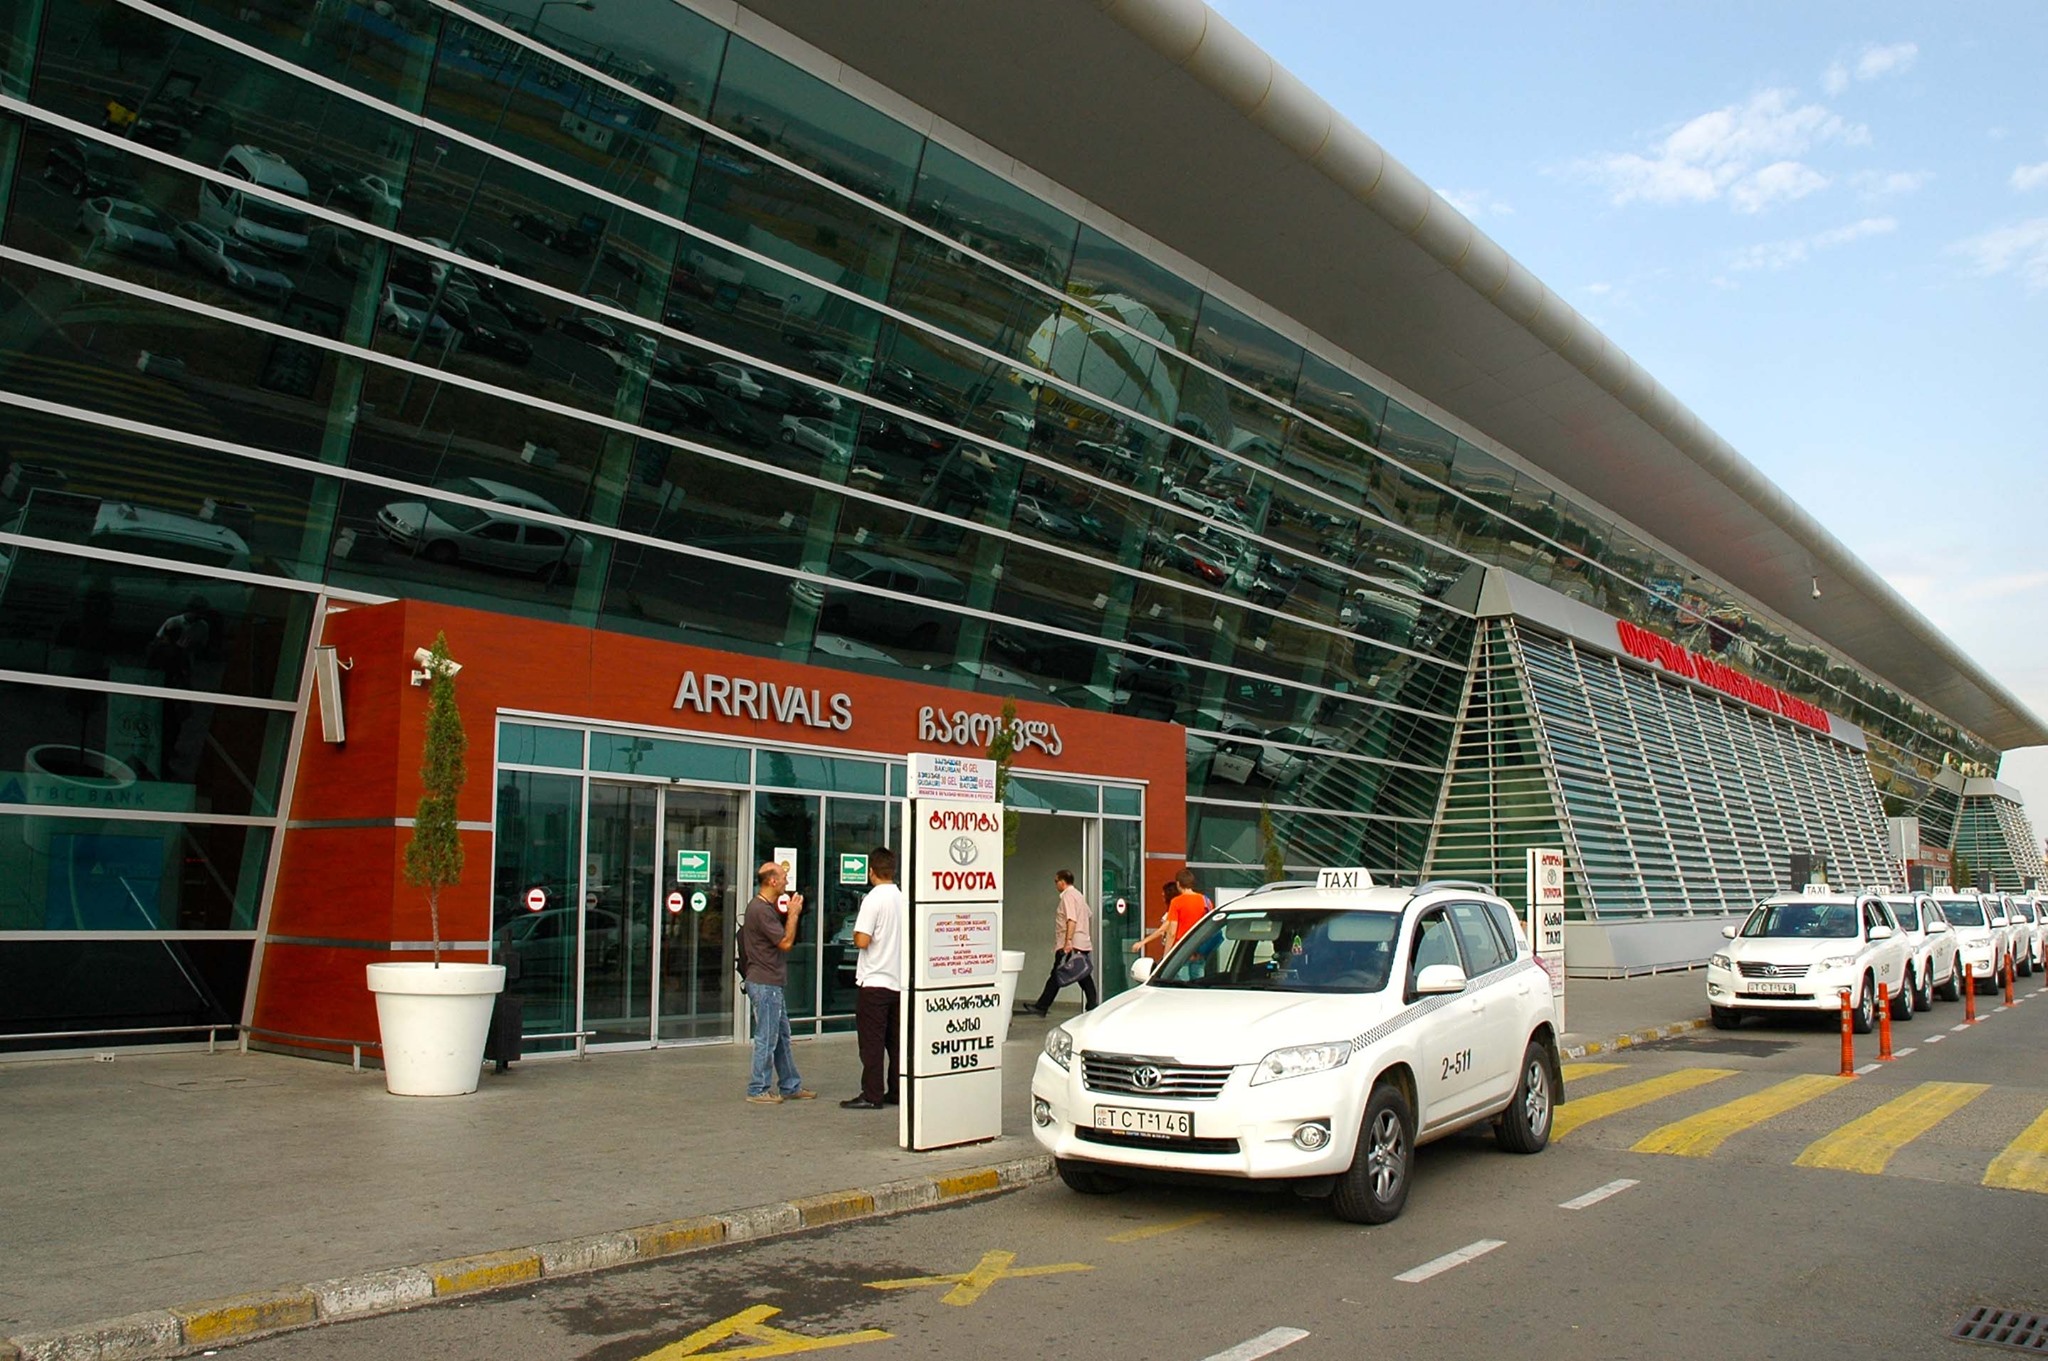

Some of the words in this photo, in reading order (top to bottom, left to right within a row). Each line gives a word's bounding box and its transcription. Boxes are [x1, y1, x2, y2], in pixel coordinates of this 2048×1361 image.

[673, 671, 853, 731] ARRIVALS
[34, 786, 76, 801] TBC
[89, 789, 145, 806] BANK
[929, 810, 999, 832] ტოიოტა
[932, 871, 997, 890] TOYOTA
[1322, 871, 1358, 888] TAXI
[1543, 887, 1562, 898] TOYOTA
[1806, 886, 1826, 895] TAXI
[1545, 931, 1561, 945] TAXI
[925, 993, 1000, 1013] სამარშრუტო
[946, 1017, 981, 1033] ტაქსი
[931, 1035, 994, 1055] SHUTTLE
[950, 1054, 978, 1070] BUS
[1441, 1048, 1471, 1080] 2-511
[1097, 1117, 1107, 1126] GE
